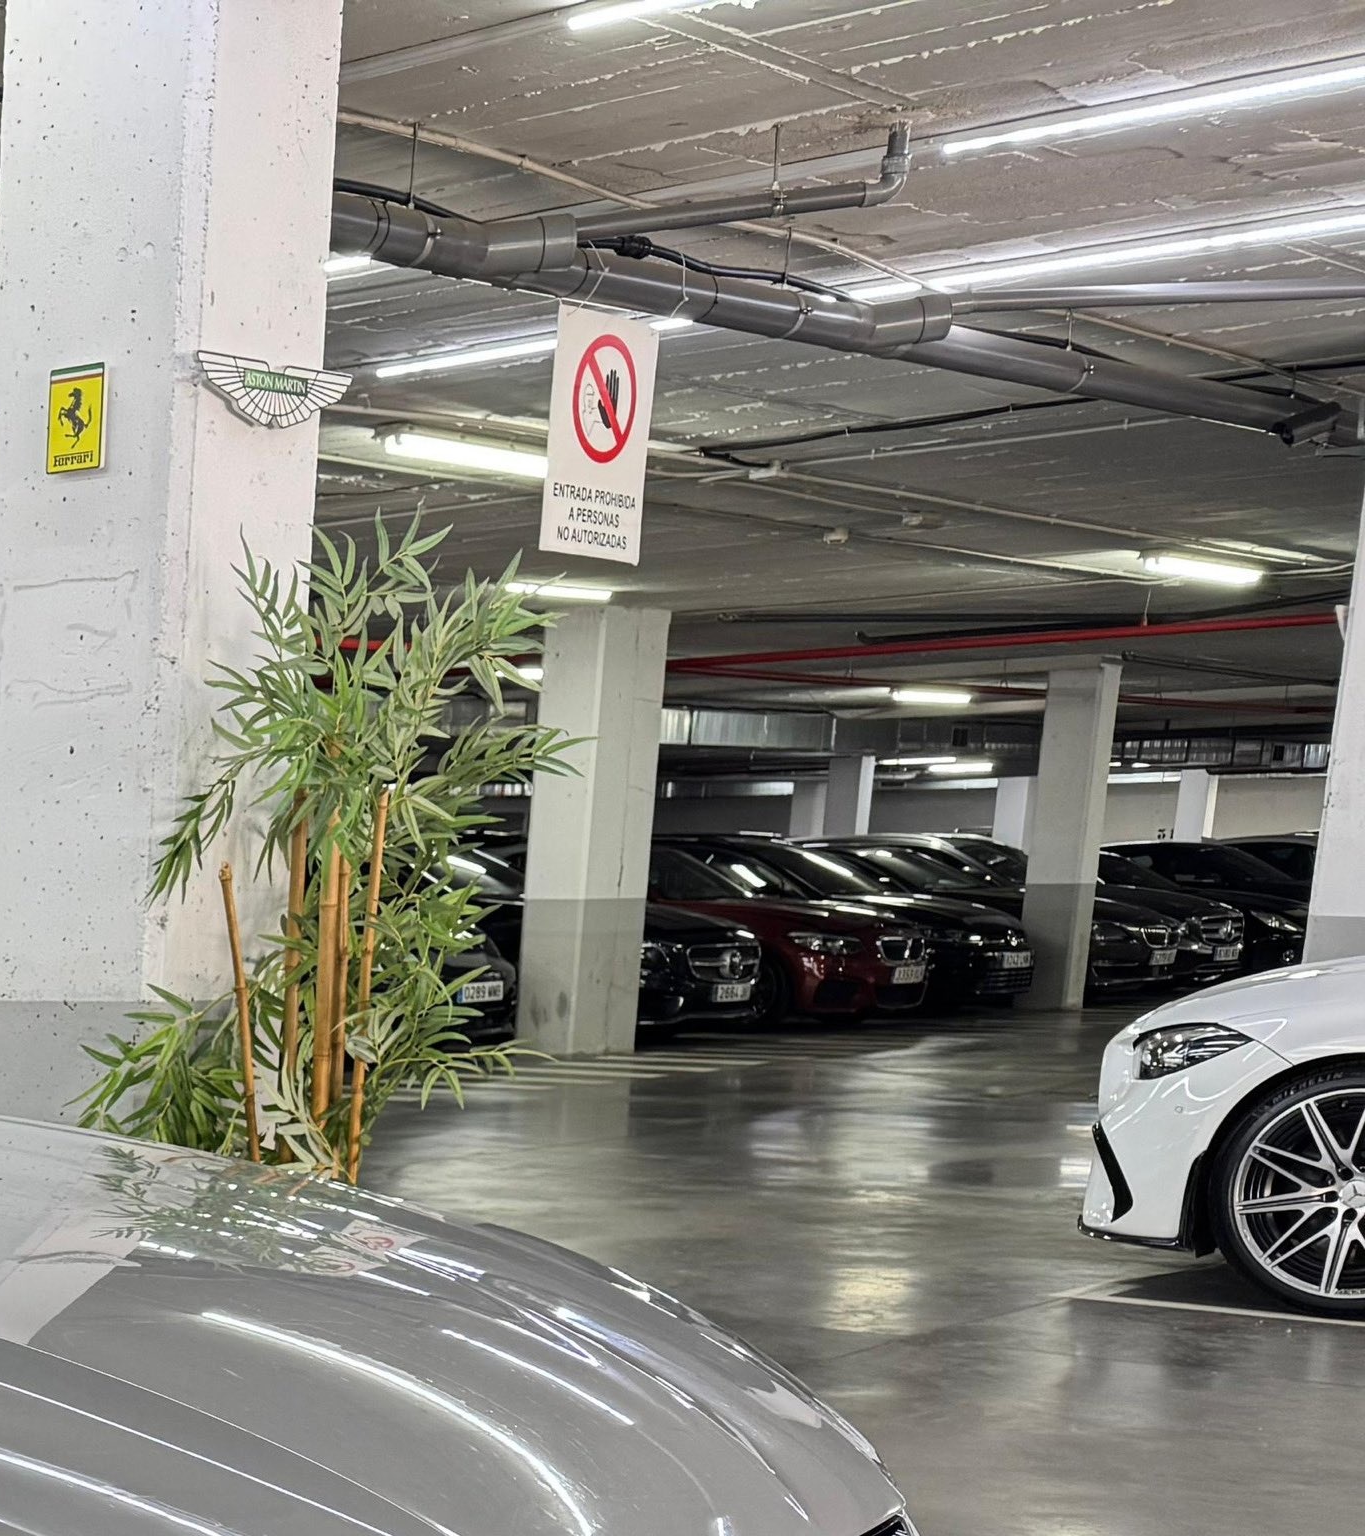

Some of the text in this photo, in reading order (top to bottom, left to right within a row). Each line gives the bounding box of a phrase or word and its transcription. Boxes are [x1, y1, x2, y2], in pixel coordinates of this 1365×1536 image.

[245, 371, 306, 394] ASTON MARTIN
[53, 450, 93, 467] Ferrari
[553, 482, 636, 510] ENTRADA PROHIBIDA
[568, 507, 620, 529] A PERSONAS
[556, 526, 627, 550] NO AUTORIZADAS
